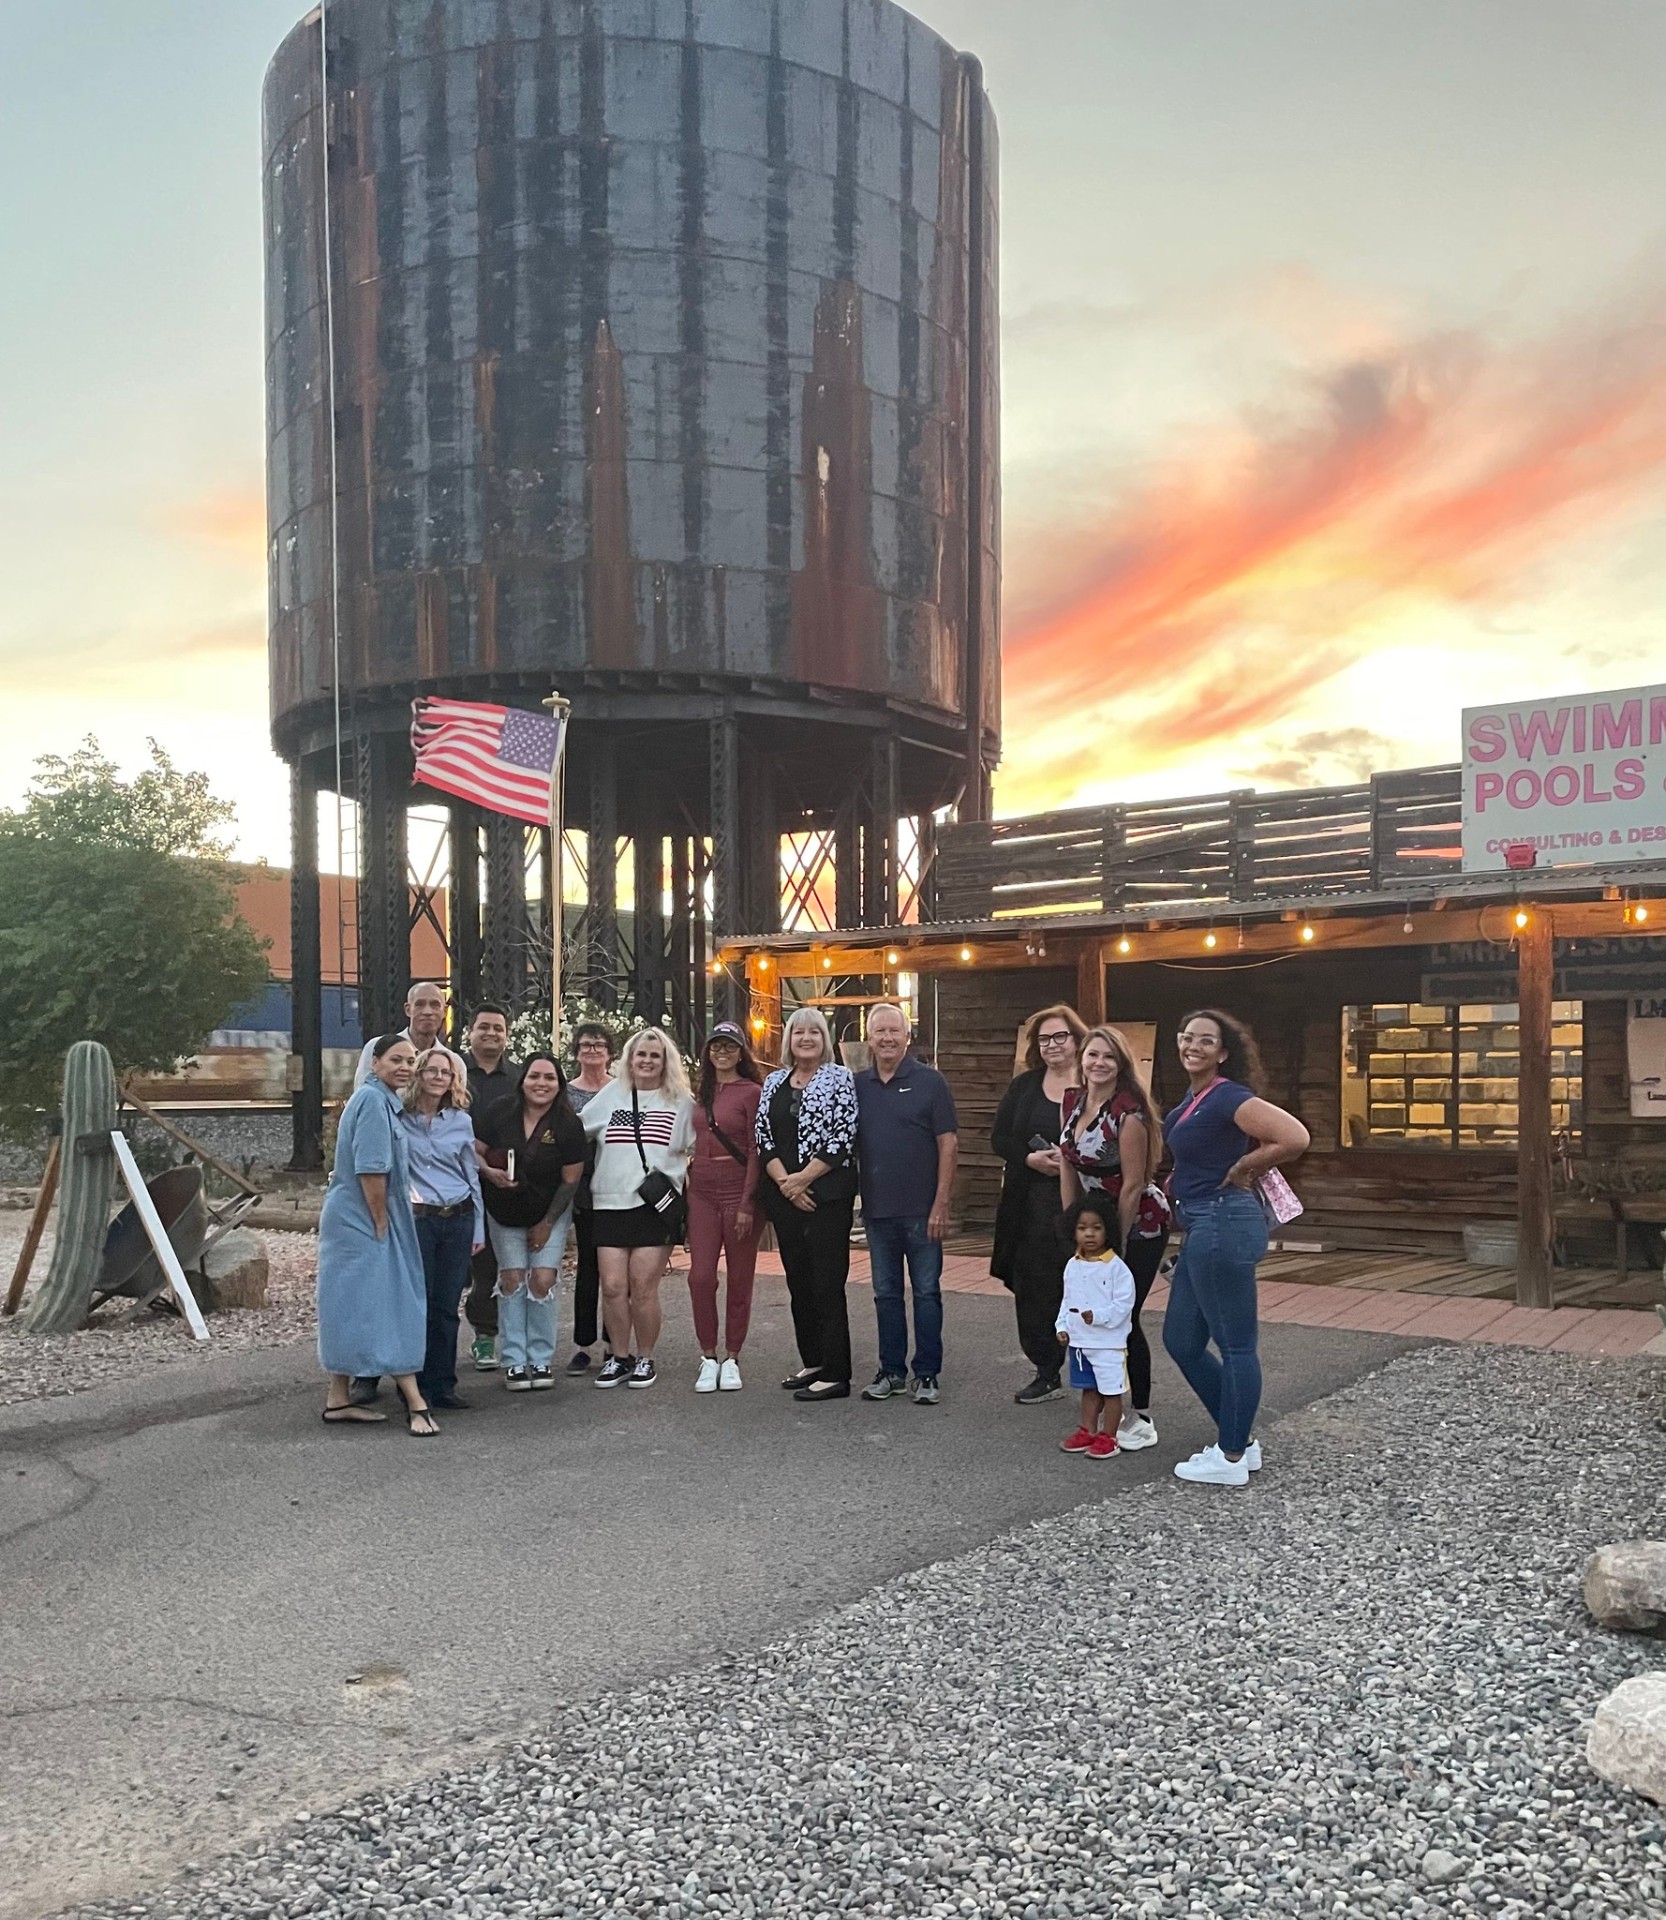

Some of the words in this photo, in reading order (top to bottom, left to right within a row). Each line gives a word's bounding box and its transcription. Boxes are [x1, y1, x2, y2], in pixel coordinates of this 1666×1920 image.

[1475, 759, 1645, 813] POOLS
[1609, 829, 1622, 844] &
[1627, 826, 1666, 843] DES
